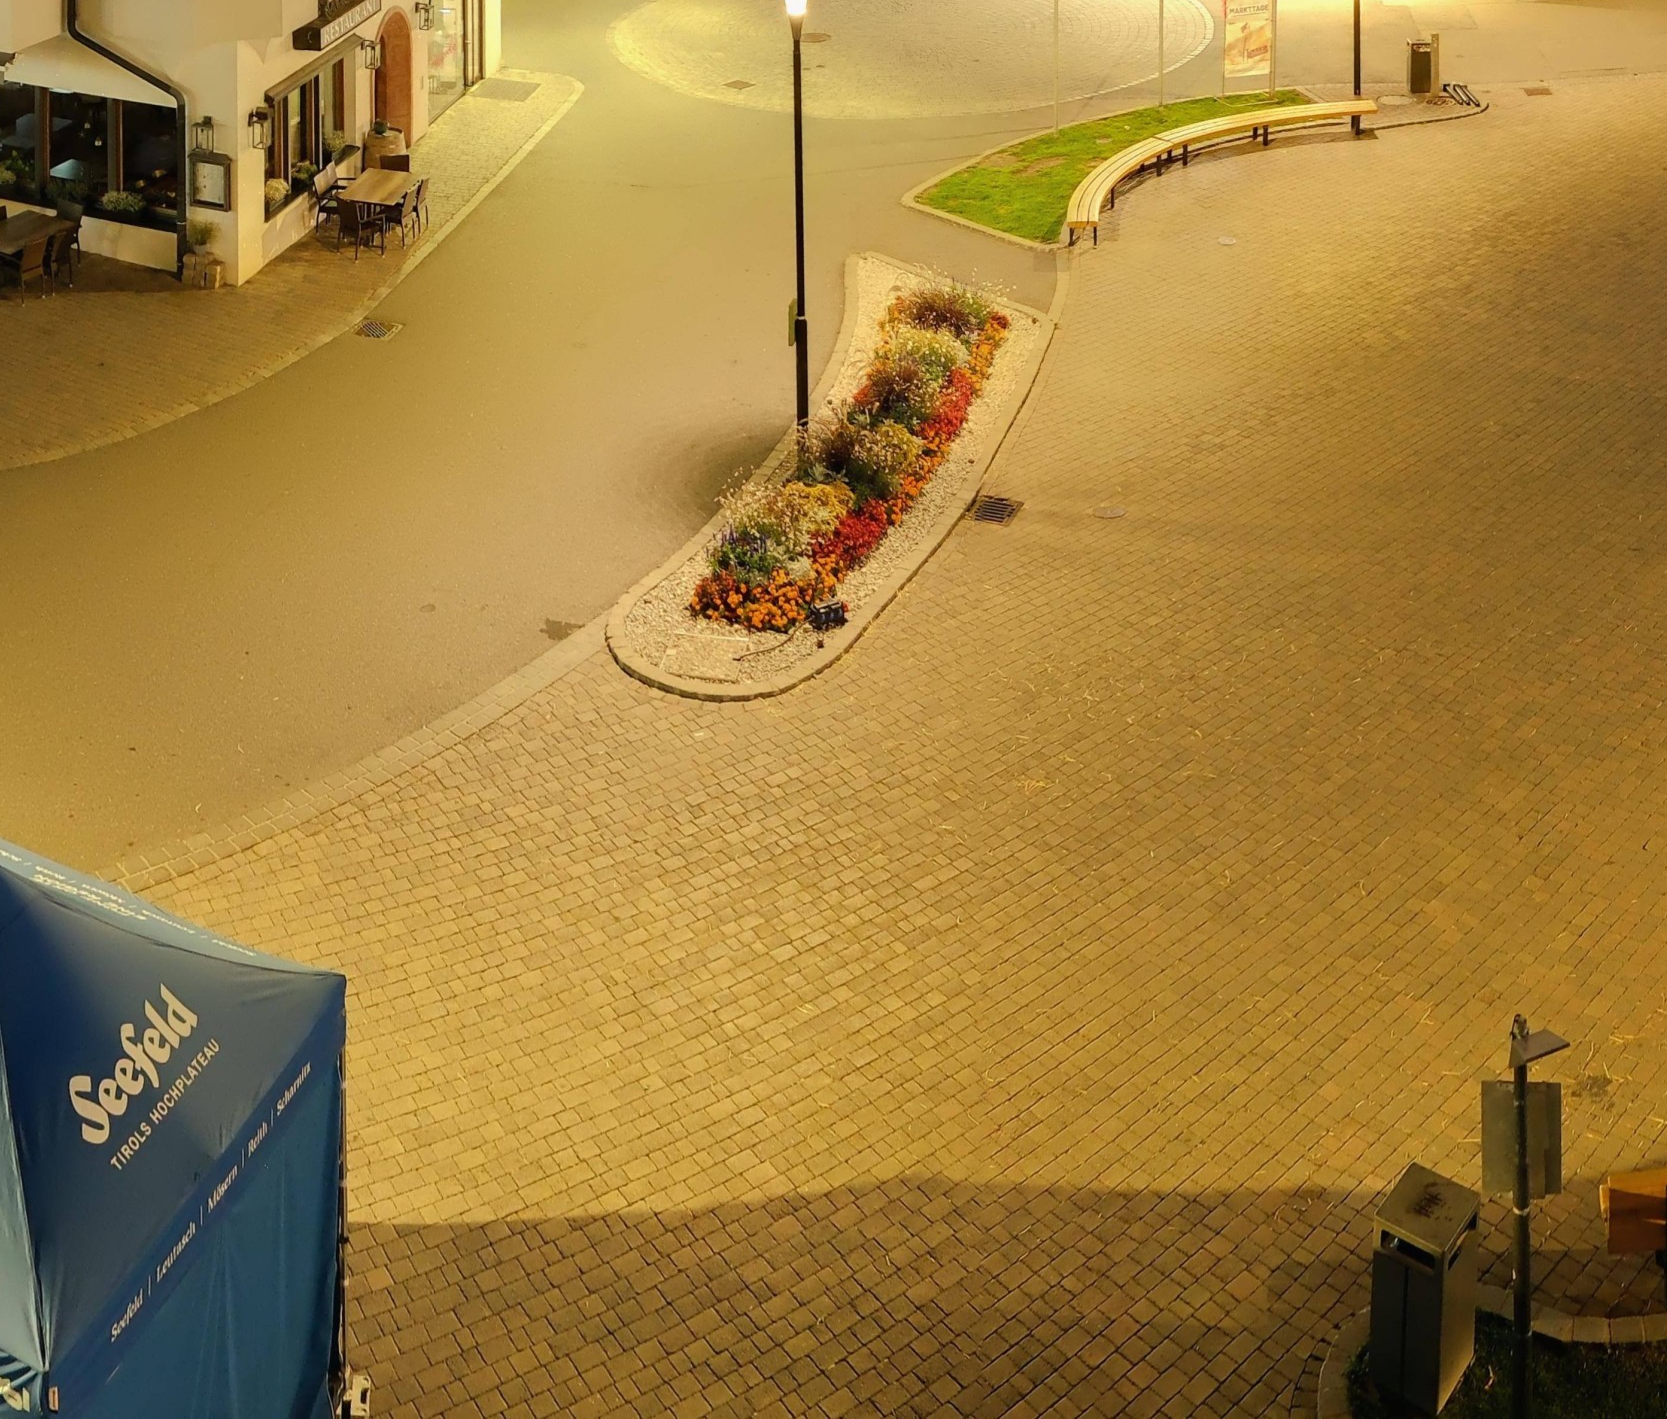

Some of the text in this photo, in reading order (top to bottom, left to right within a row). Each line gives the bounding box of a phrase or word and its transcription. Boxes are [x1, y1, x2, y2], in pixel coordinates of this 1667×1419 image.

[69, 982, 198, 1144] Seefeld
[110, 1038, 221, 1171] TIROLS HOCHPLATEAU
[111, 1061, 312, 1343] Seefeld Leutasch Mösern Reith Scharnitz
